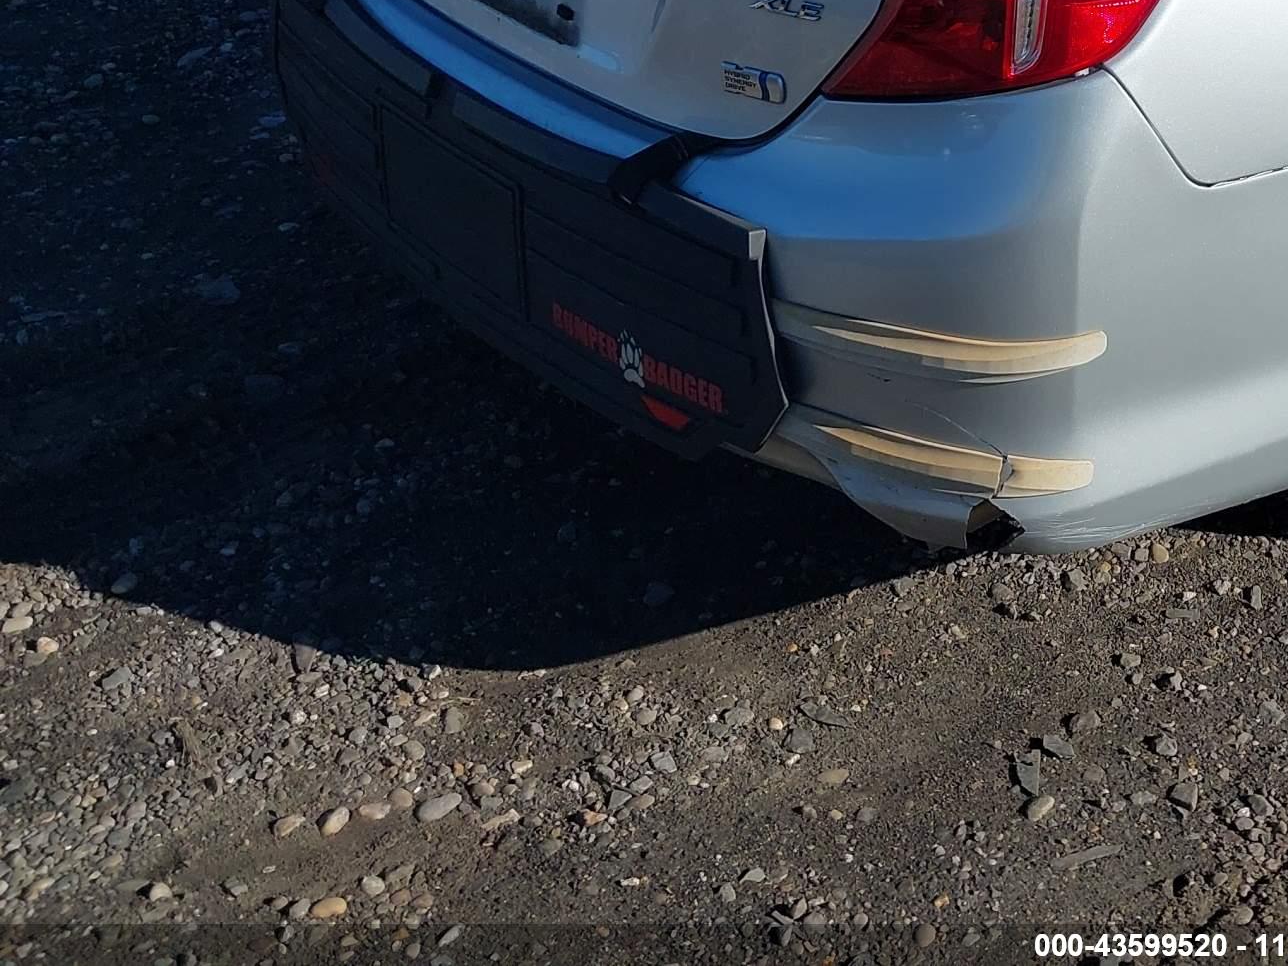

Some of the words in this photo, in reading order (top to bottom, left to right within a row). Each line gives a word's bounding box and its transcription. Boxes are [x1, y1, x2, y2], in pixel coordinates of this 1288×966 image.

[724, 75, 756, 89] SYNERGY
[552, 301, 618, 363] BUMPER
[643, 353, 723, 414] BADGER
